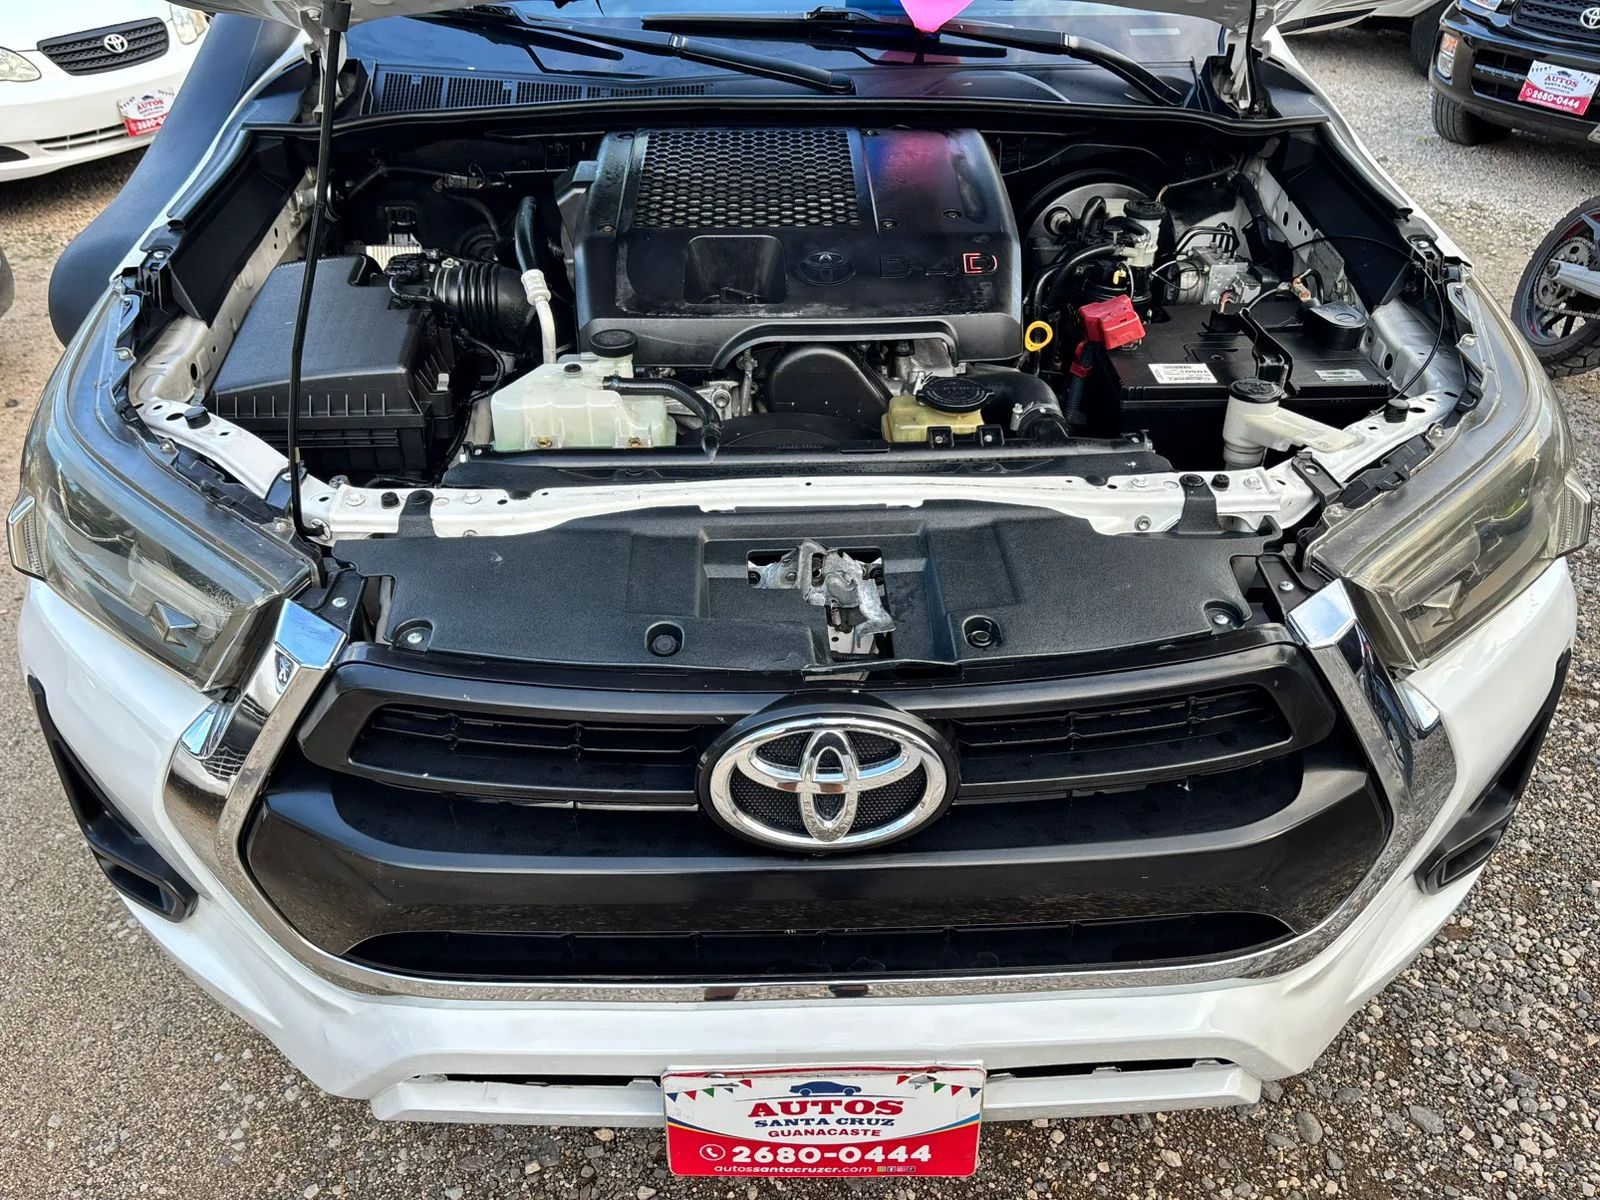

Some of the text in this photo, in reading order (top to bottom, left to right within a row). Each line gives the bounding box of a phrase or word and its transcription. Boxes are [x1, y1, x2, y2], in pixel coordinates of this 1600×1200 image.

[1544, 75, 1578, 88] AUTOS
[1532, 90, 1579, 109] 2680-0444
[748, 1099, 904, 1117] AUTOS
[754, 1117, 895, 1128] SANTA CRUZ
[768, 1128, 882, 1138] GUANACASTE
[731, 1144, 932, 1164] 2680-0444
[713, 1165, 873, 1174] autossantacruzcr.com
